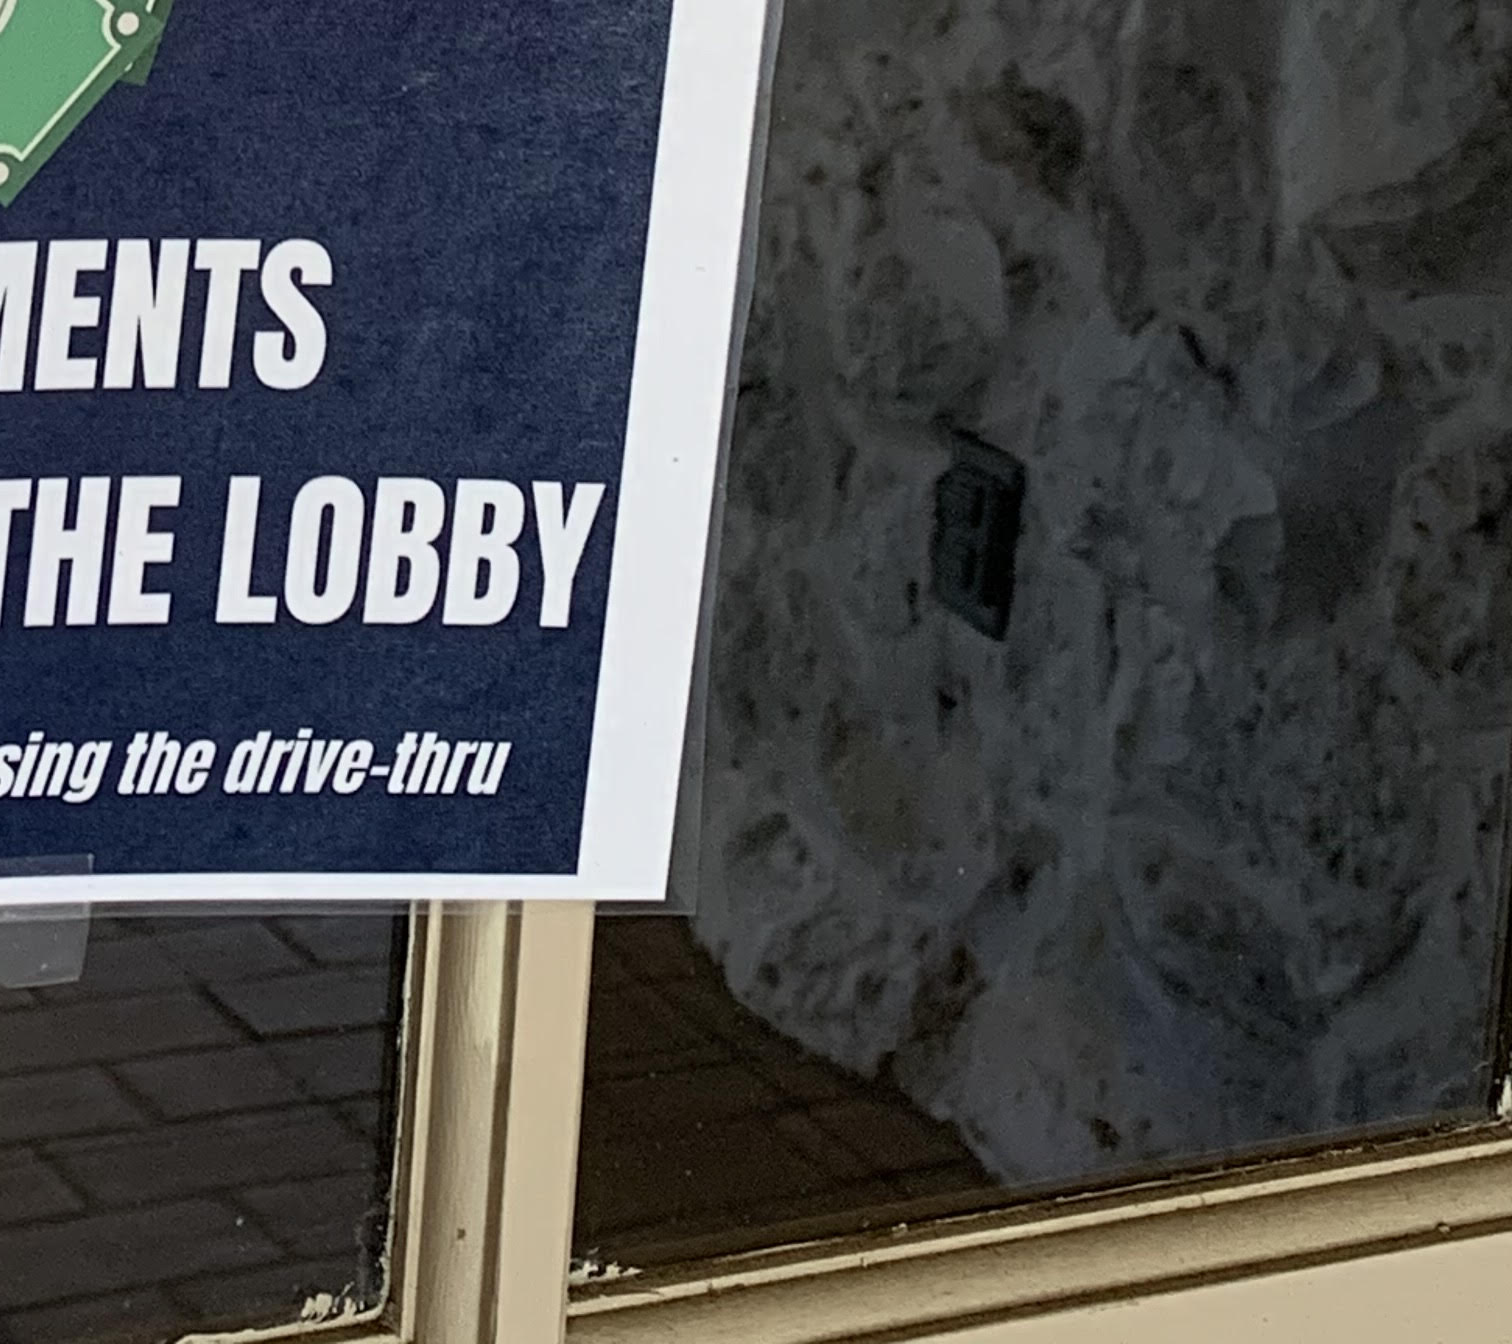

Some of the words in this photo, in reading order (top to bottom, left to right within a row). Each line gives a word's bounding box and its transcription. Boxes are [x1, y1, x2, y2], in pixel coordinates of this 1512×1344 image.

[212, 472, 609, 631] LOBBY
[114, 728, 219, 798] the
[220, 726, 515, 798] drive-thru
